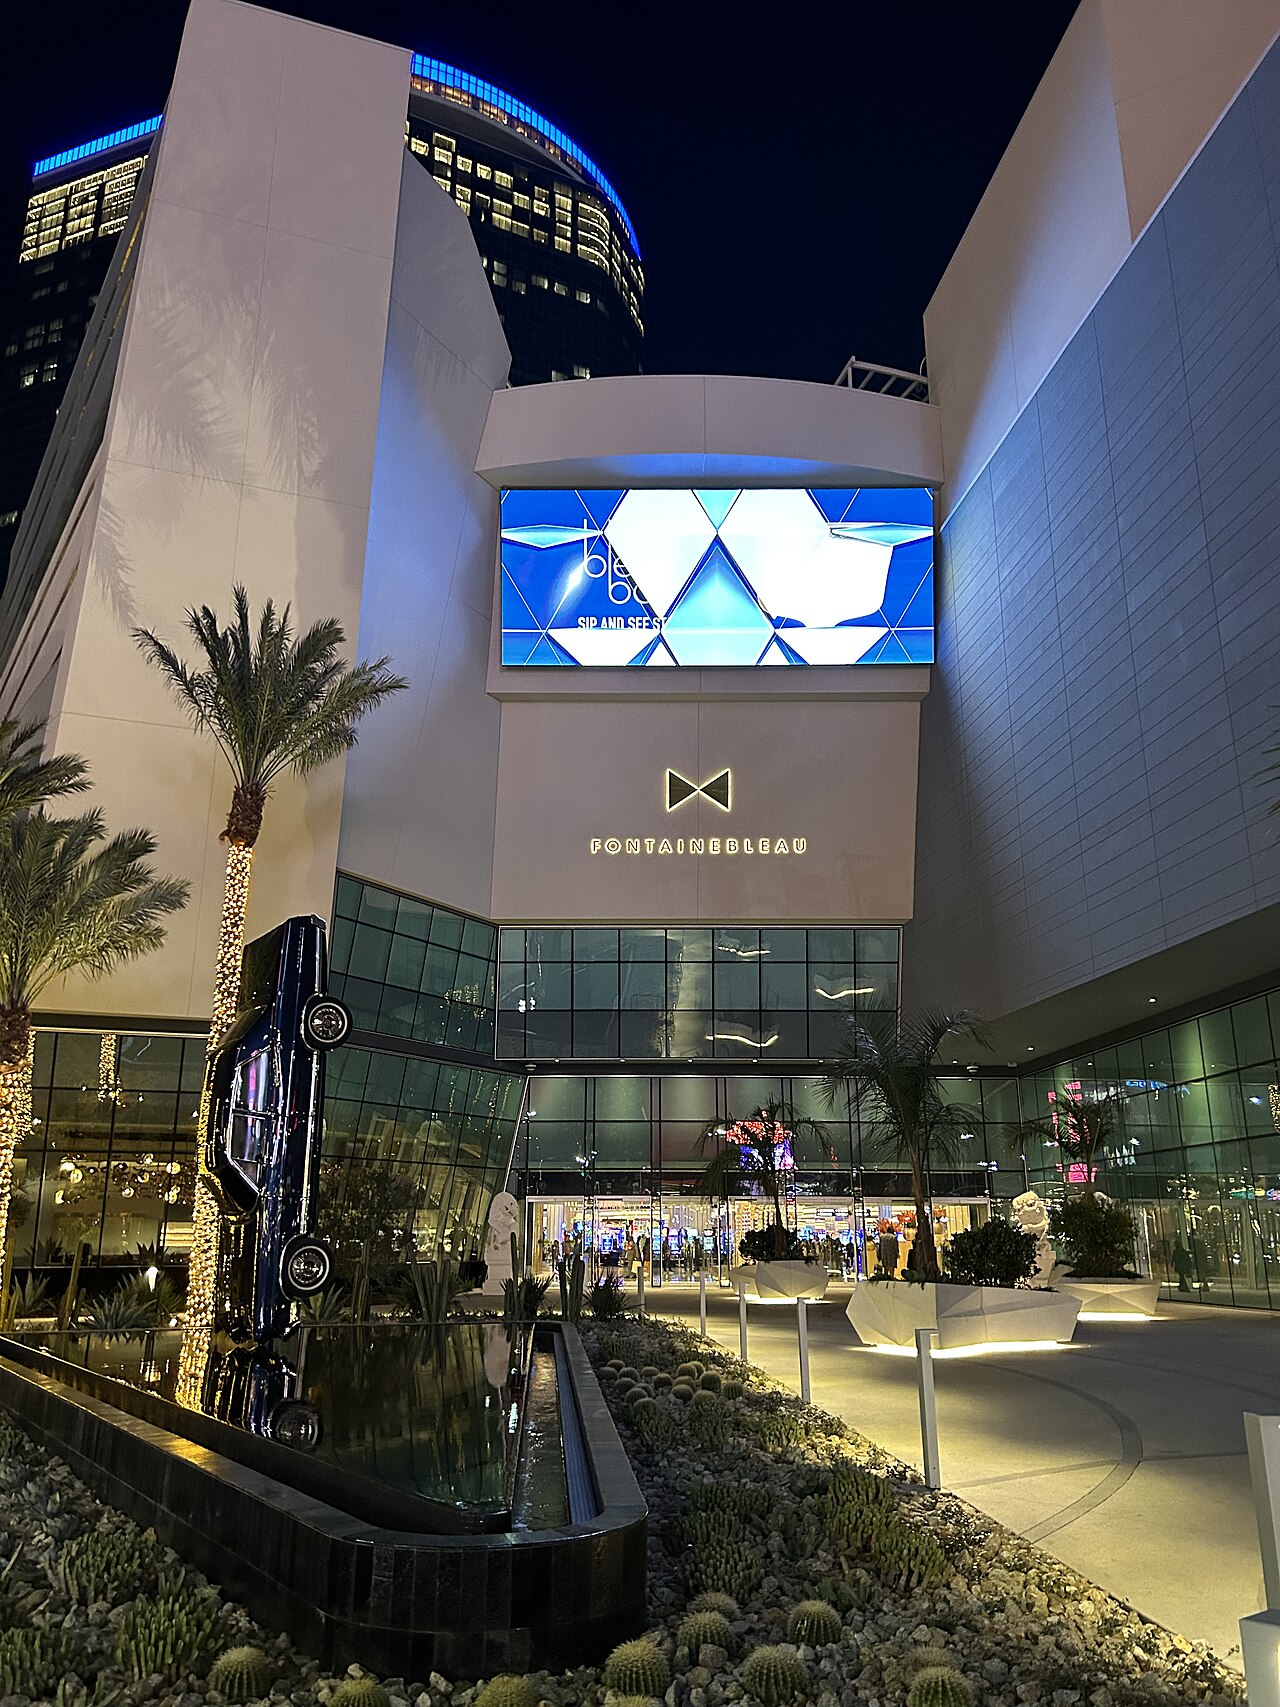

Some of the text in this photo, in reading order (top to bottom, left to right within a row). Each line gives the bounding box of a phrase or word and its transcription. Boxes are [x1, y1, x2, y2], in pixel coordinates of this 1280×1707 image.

[584, 518, 630, 578] ble
[577, 616, 668, 630] SIP AND SEE ST
[590, 837, 808, 856] FONTAINEBLEAU
